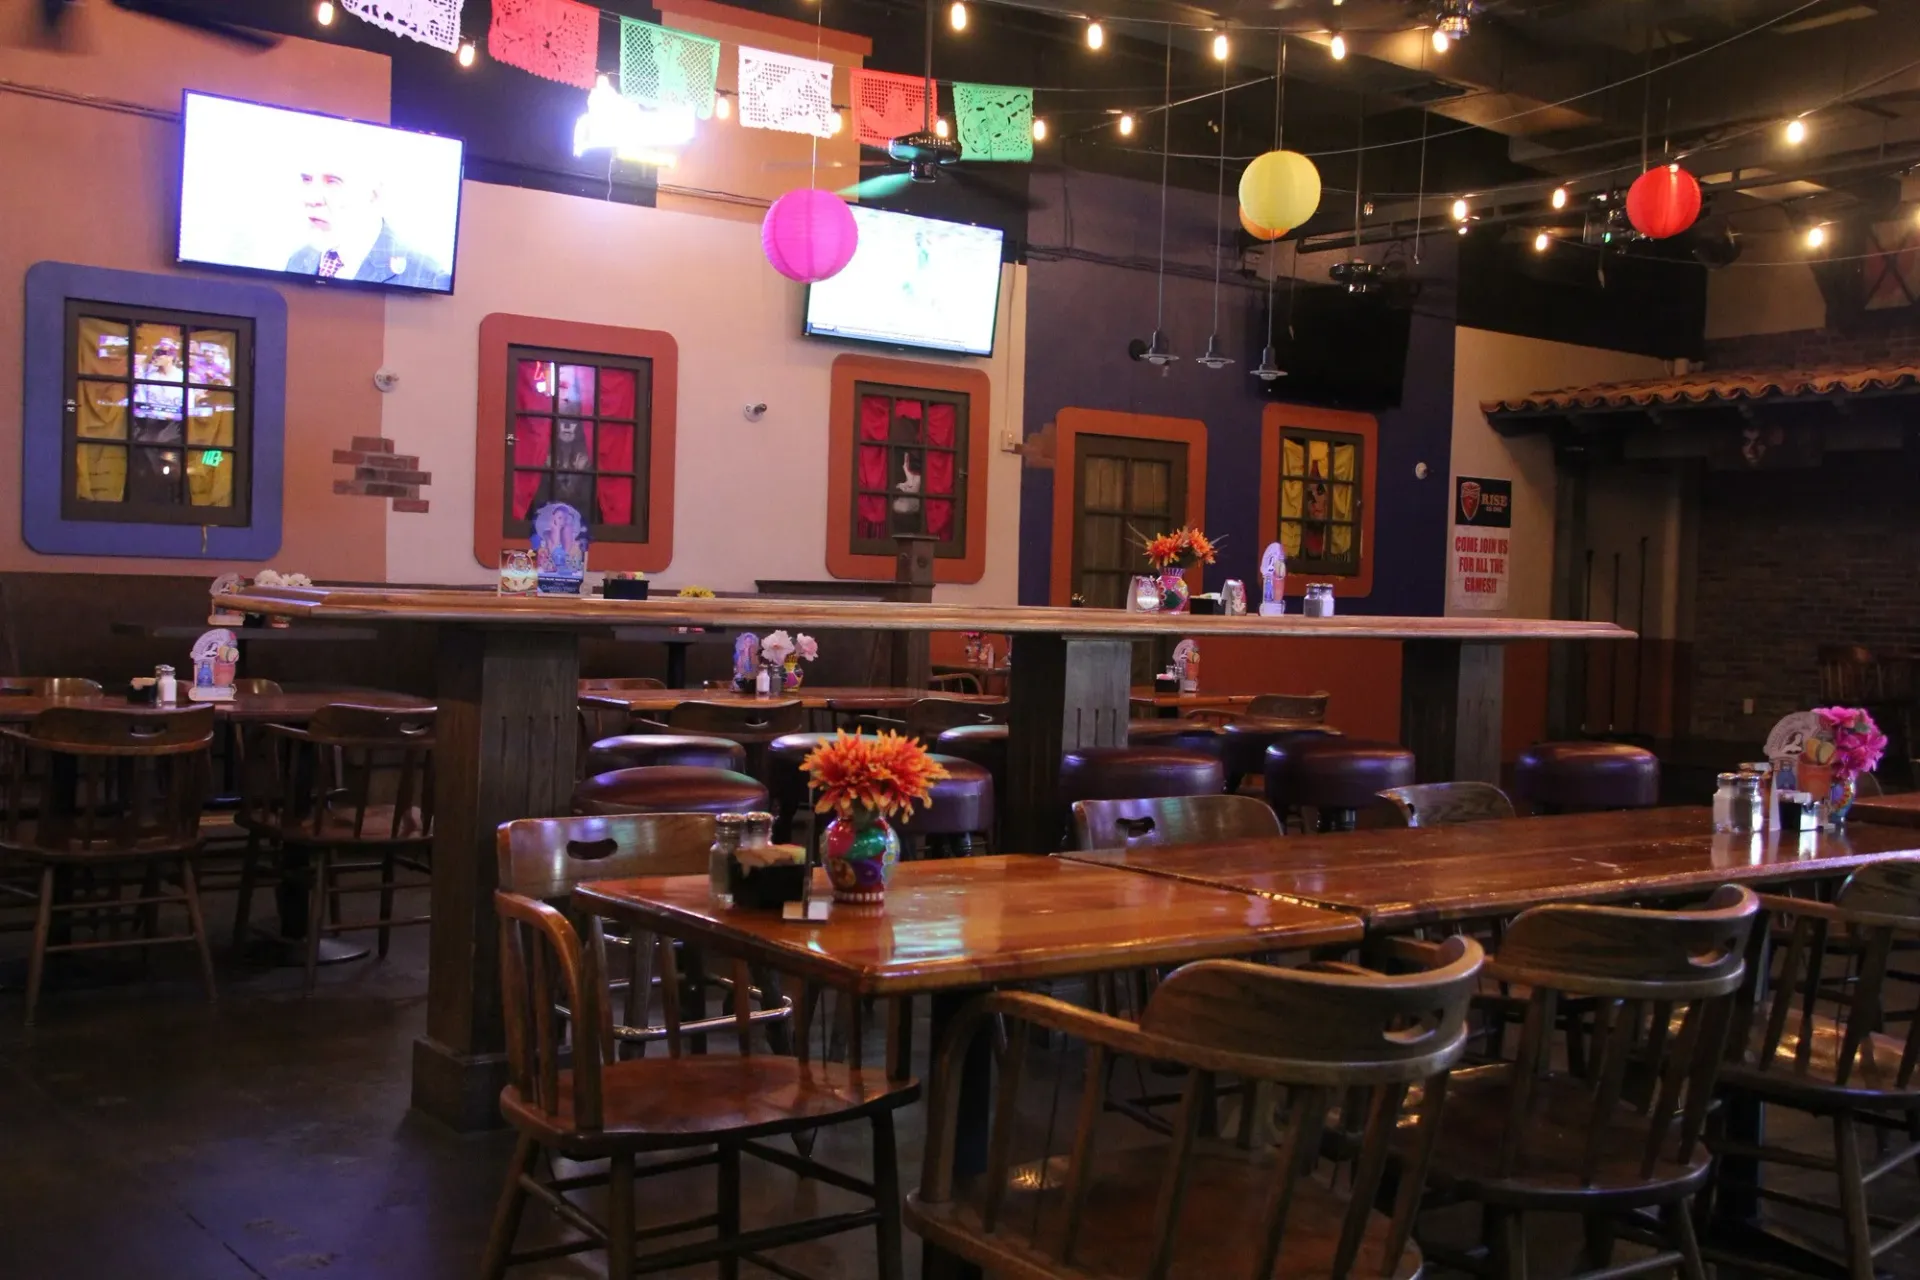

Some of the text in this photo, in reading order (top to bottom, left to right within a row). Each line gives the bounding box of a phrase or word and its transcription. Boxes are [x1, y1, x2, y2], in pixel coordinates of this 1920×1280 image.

[1481, 494, 1507, 506] RISE
[1455, 536, 1508, 555] COME JOIN US
[1459, 556, 1504, 574] FOR ALL THE
